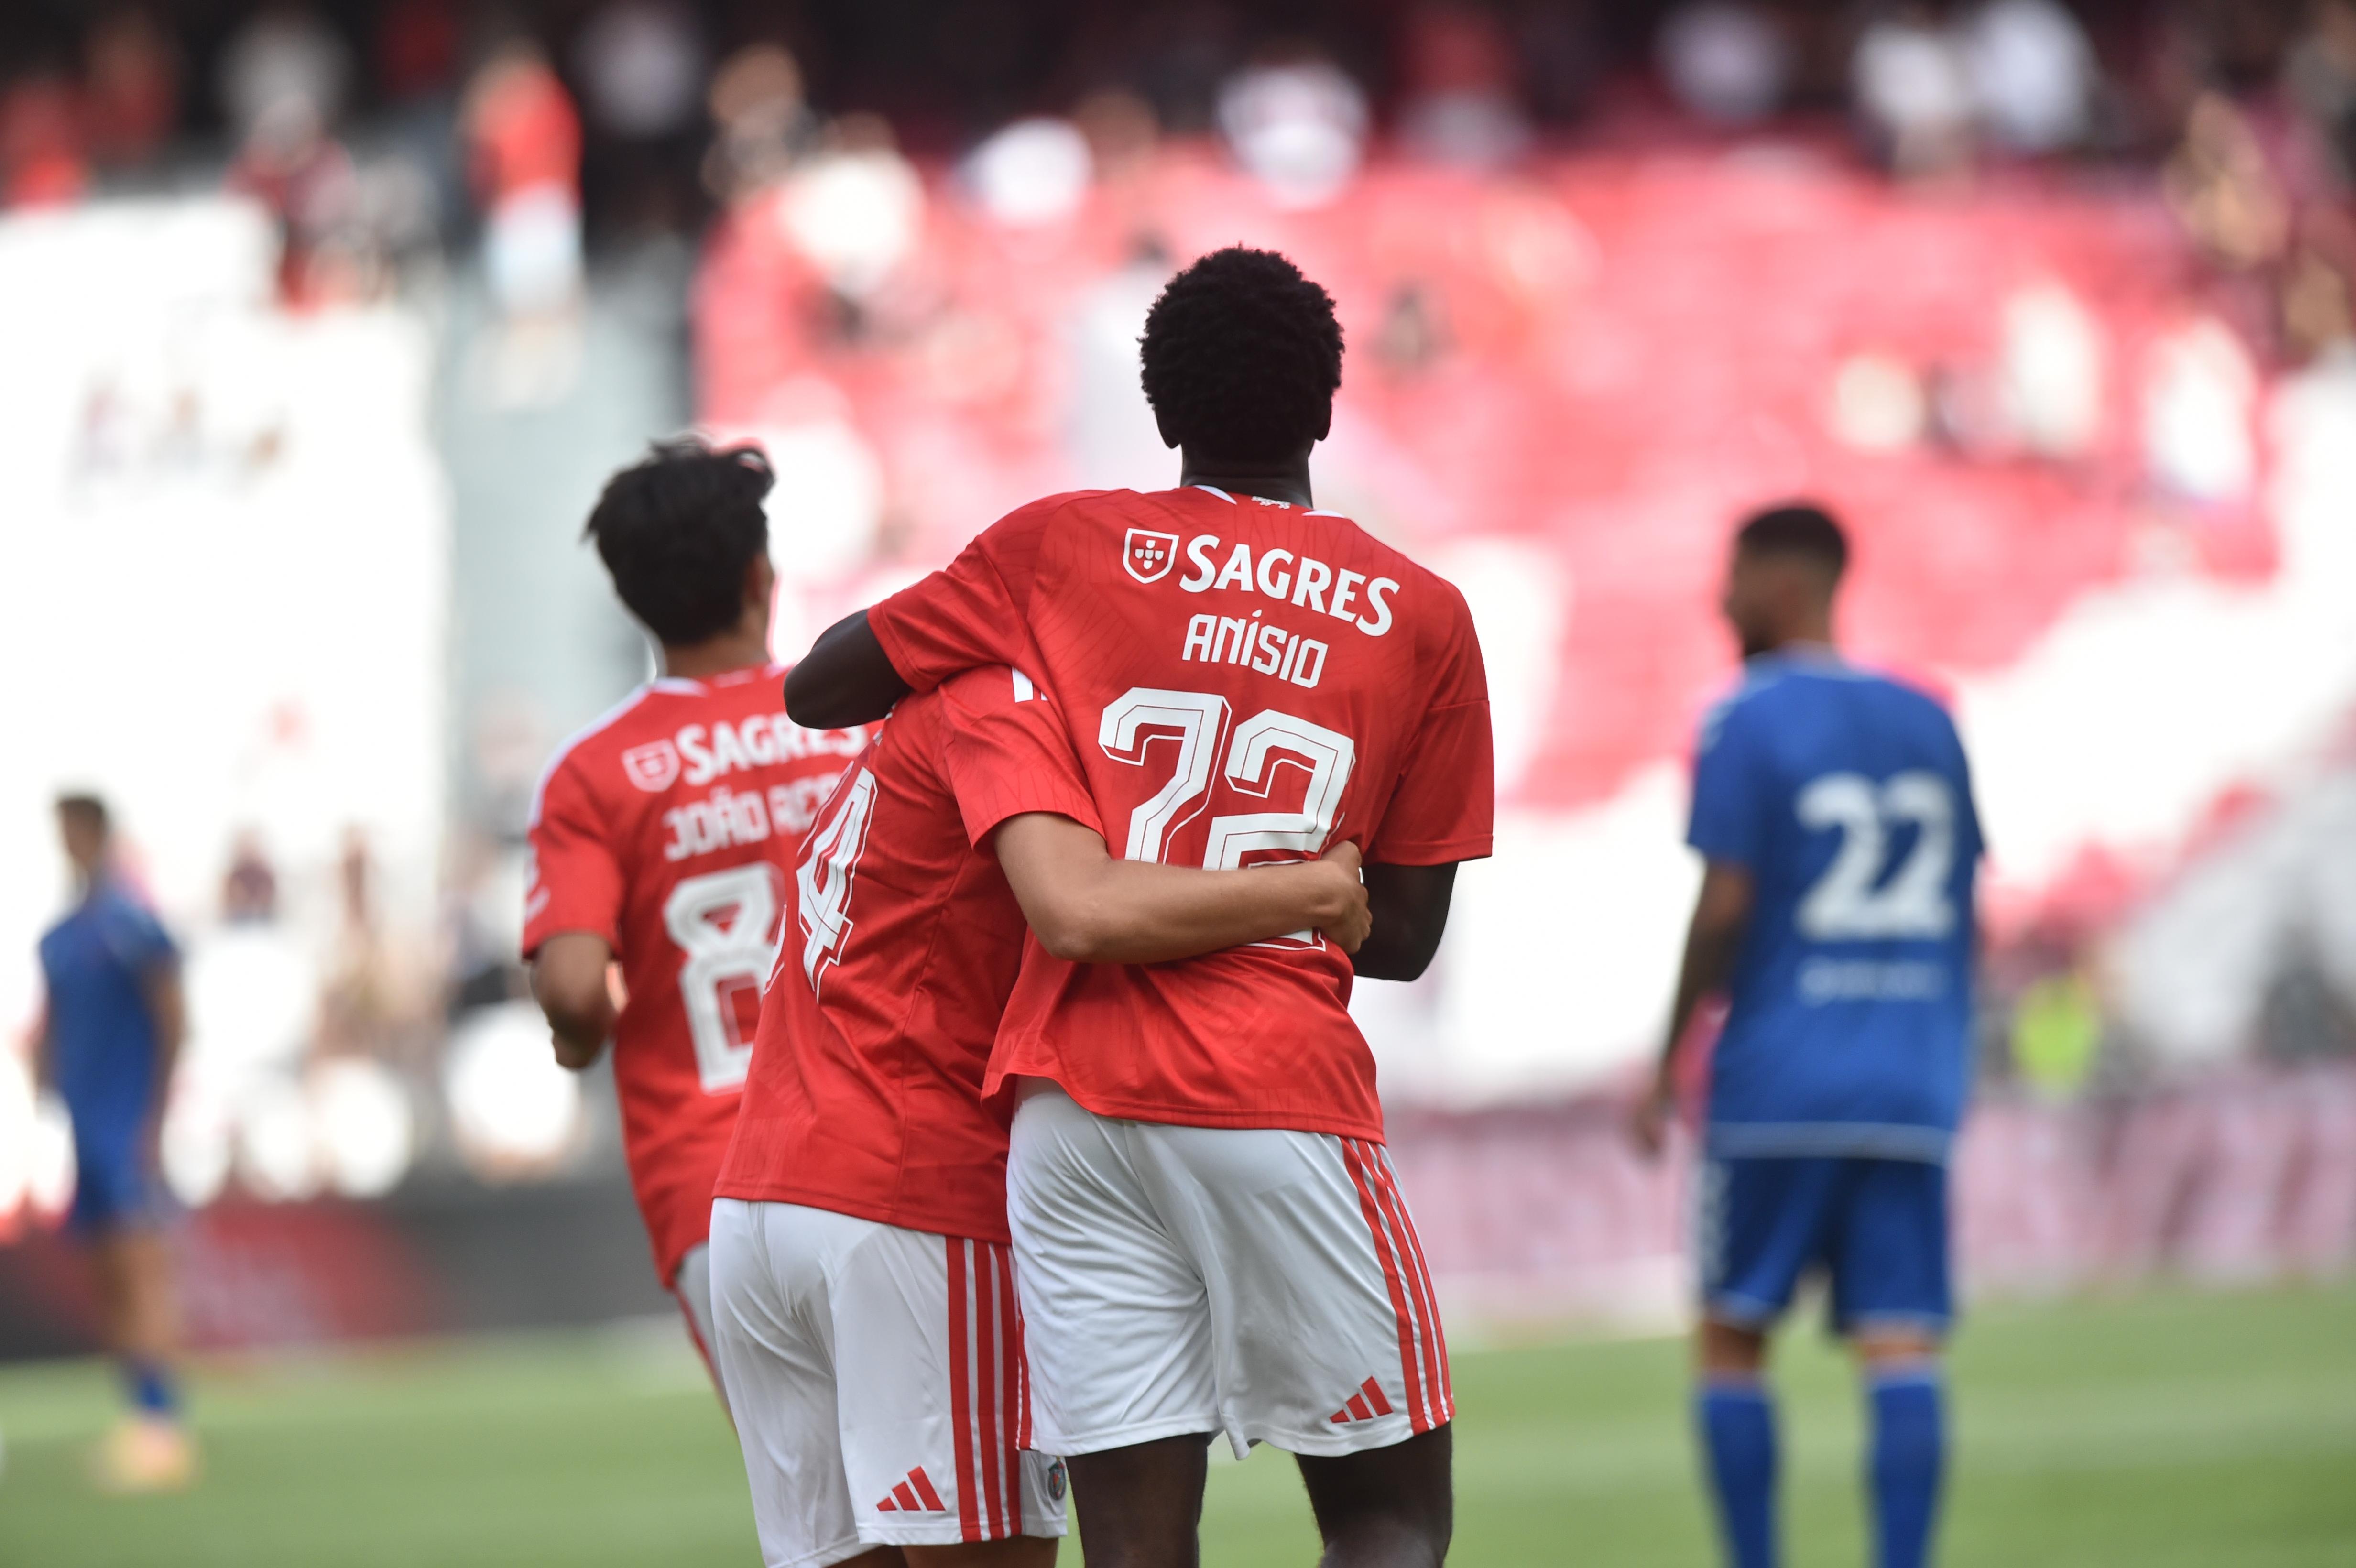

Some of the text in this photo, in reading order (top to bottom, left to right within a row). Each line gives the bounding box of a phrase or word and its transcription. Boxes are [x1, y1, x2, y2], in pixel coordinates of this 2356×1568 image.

[1179, 534, 1400, 637] SAGRES
[1182, 609, 1328, 689] ANÍSIO
[663, 786, 771, 860] JOÃO
[1098, 687, 1356, 951] 72
[1798, 772, 1955, 941] 22
